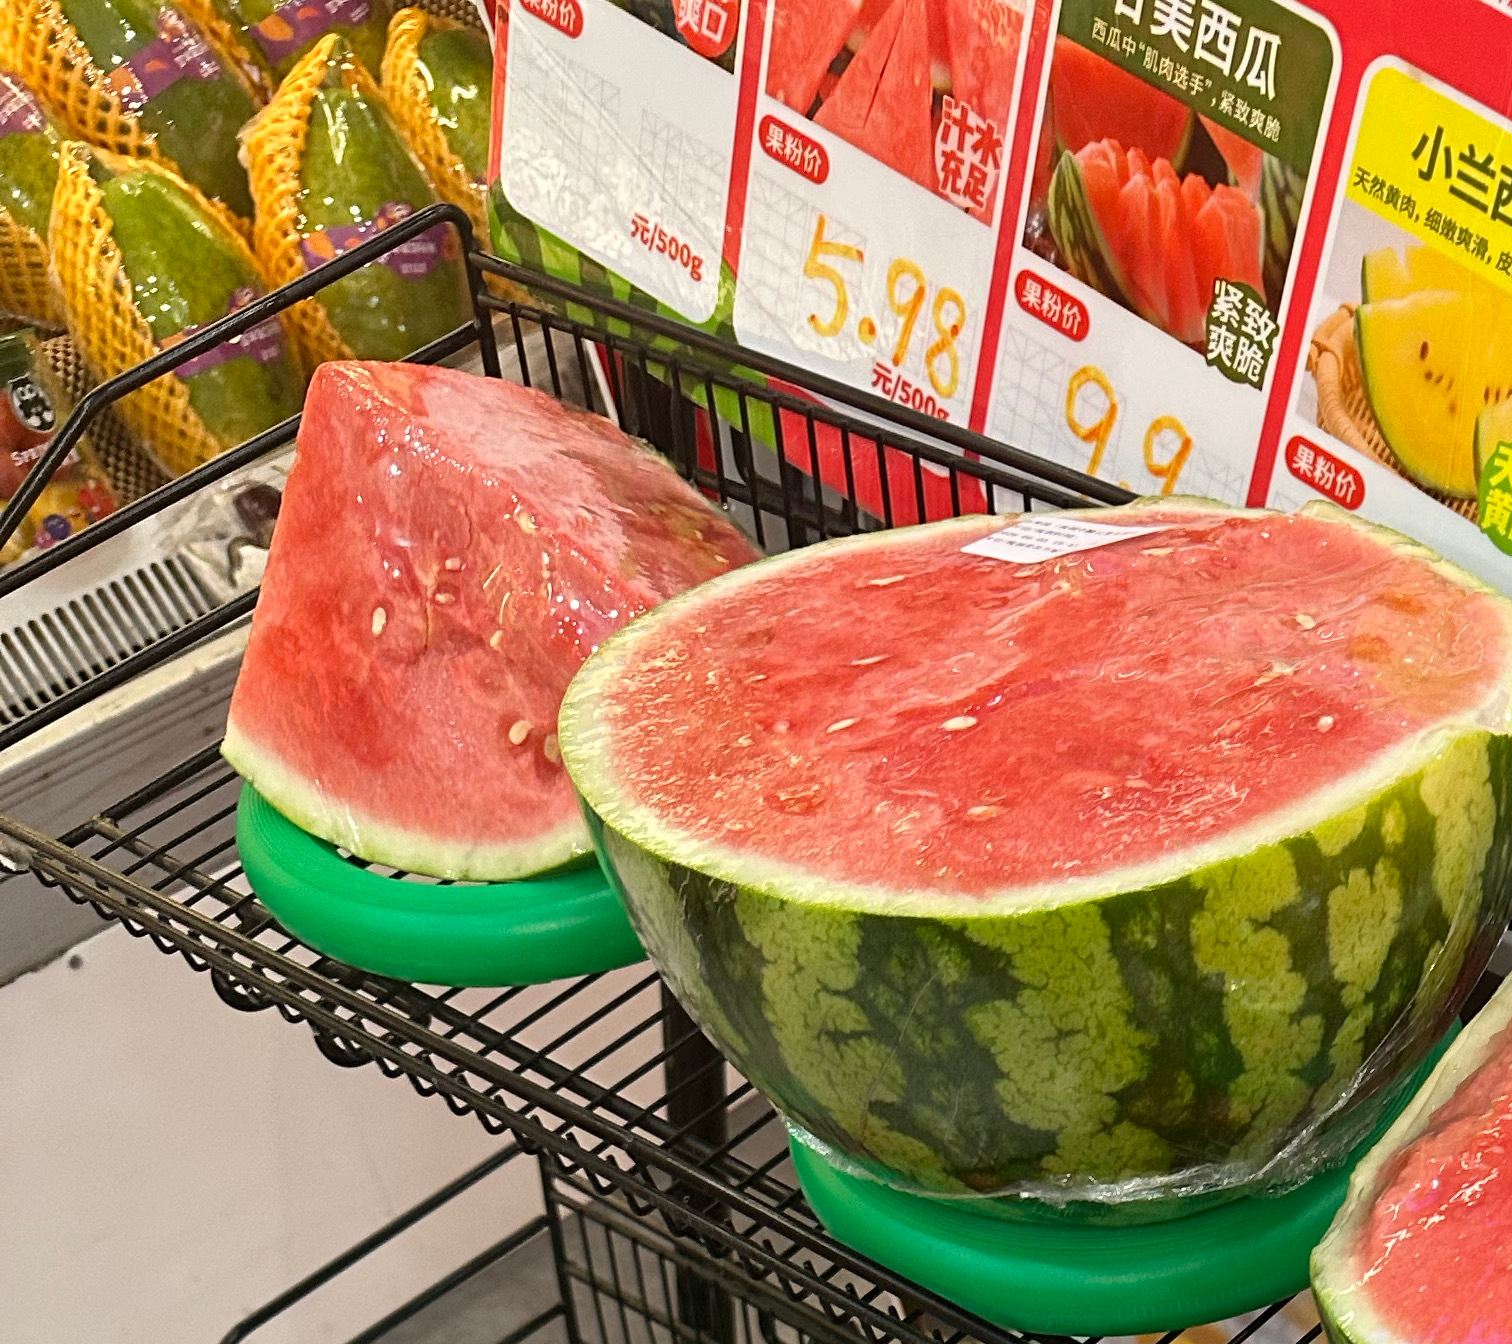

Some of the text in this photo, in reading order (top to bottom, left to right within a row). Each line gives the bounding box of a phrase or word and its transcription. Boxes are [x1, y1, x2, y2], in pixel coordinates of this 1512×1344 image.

[765, 121, 823, 179] 果粉价
[942, 97, 1001, 175] 汁水
[937, 153, 990, 212] 充足
[631, 212, 704, 282] 元/500g
[803, 212, 967, 398] 5.98
[1022, 279, 1084, 337] 果粉价
[1213, 279, 1278, 350] 紧致
[1206, 325, 1264, 384] 爽脆
[1291, 443, 1358, 504] 果粉价
